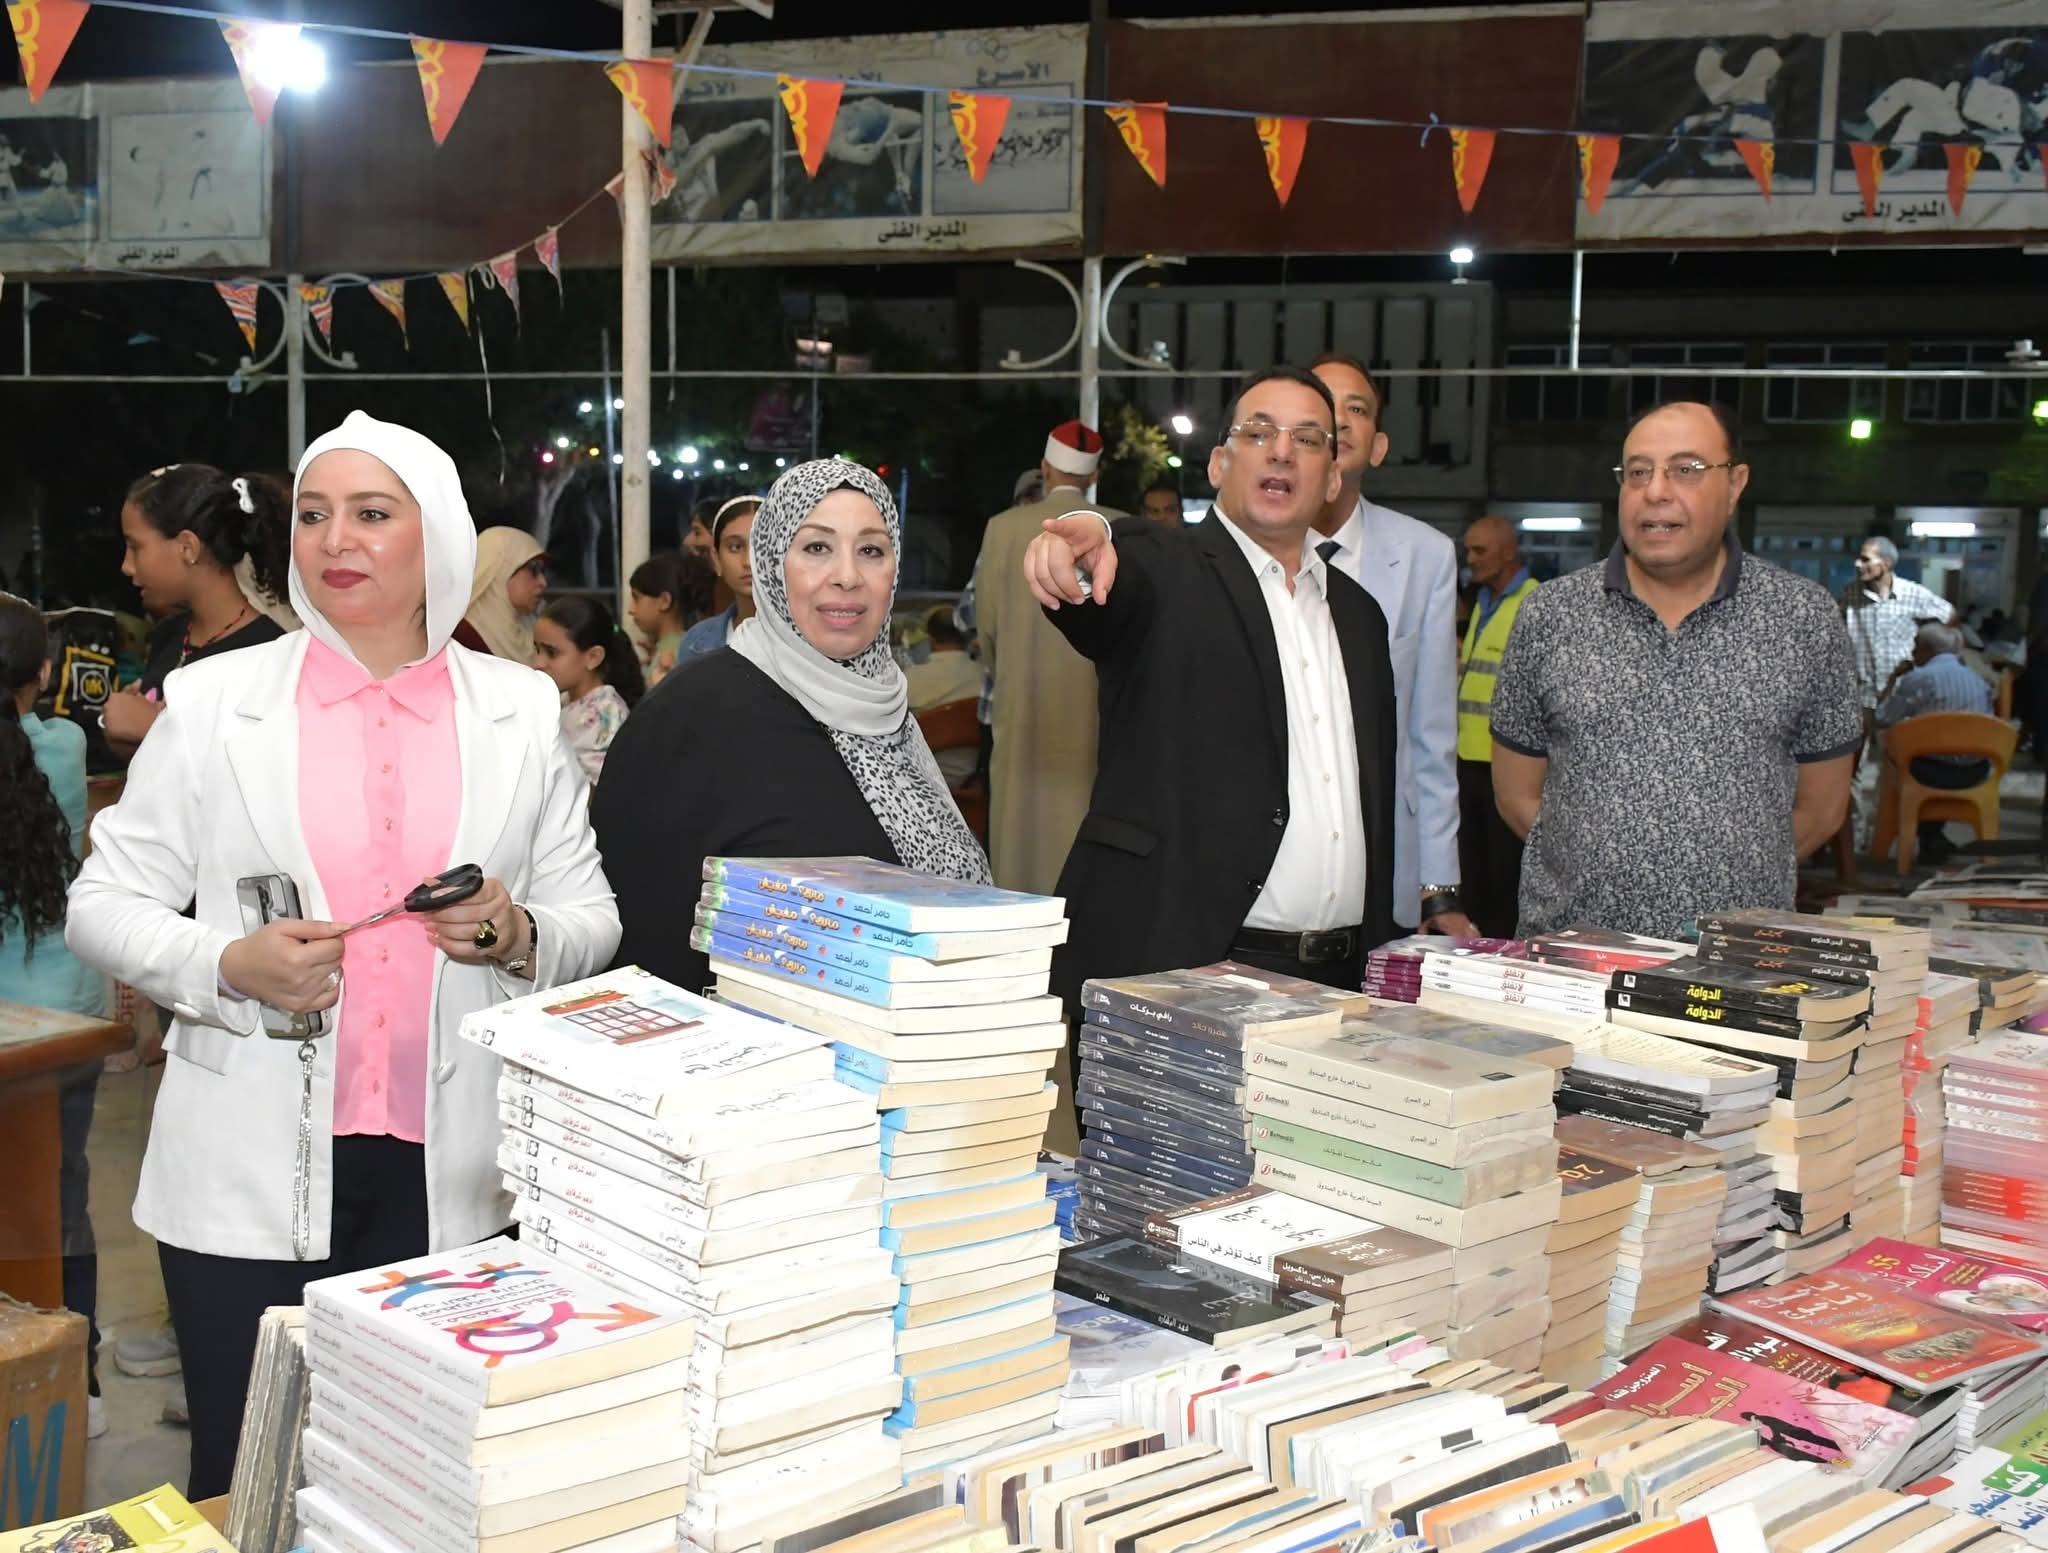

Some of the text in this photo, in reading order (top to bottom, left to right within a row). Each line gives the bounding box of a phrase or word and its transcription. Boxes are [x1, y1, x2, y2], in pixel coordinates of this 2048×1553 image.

[1686, 984, 1721, 1001] الدوامة
[1685, 1003, 1721, 1020] الدوامة
[1187, 1236, 1210, 1249] الناس
[1243, 1254, 1263, 1265] كيف
